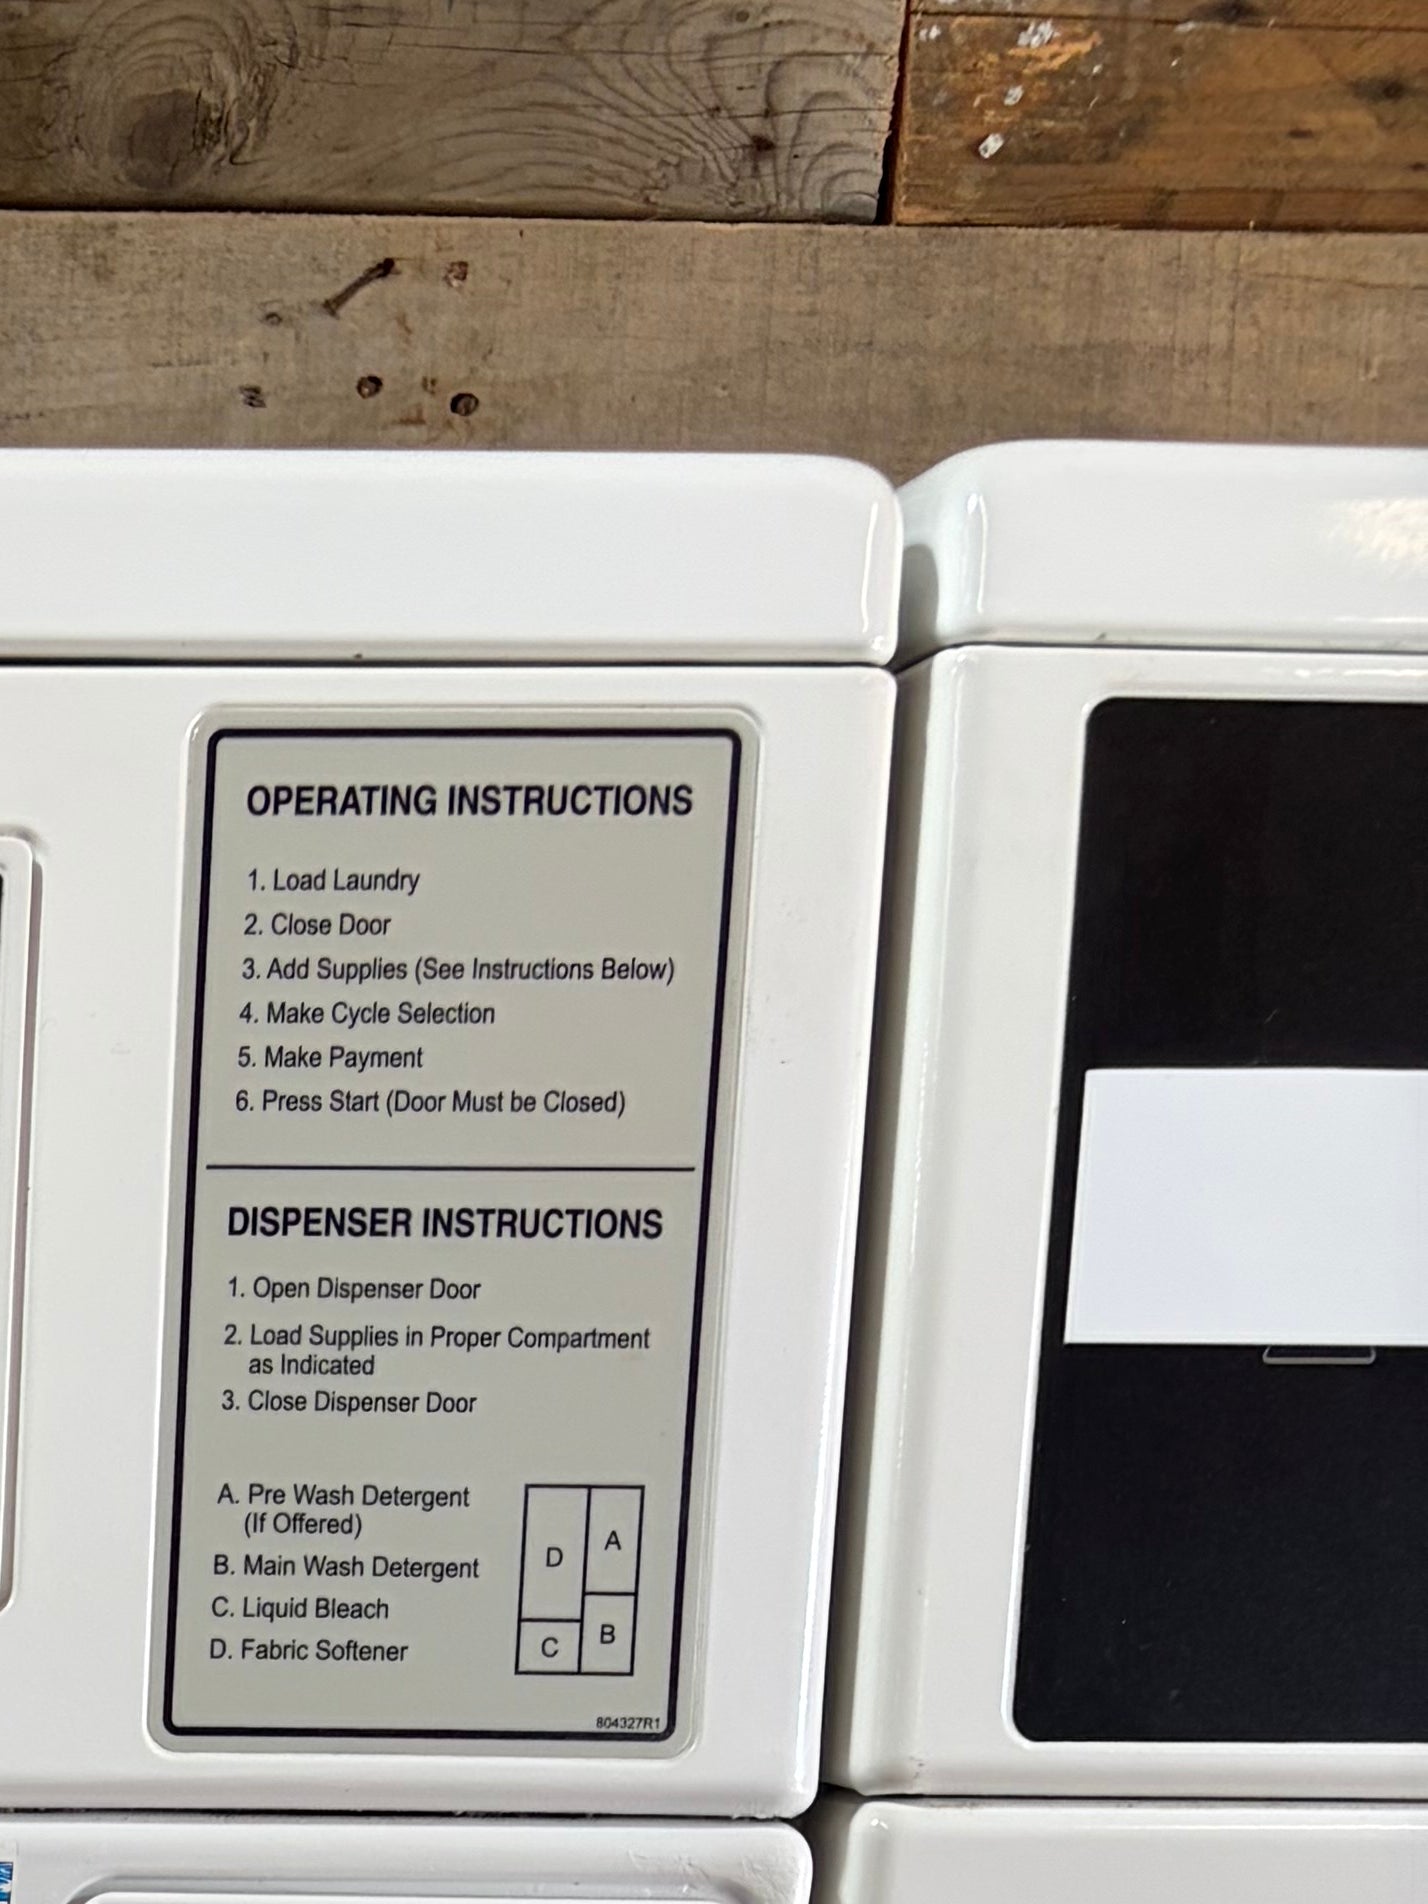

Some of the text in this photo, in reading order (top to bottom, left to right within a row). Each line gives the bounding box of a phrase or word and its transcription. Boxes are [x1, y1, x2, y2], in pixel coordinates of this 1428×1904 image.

[247, 784, 693, 816] OPERATING INSTRUCTIONS
[248, 867, 421, 897] 1. Load Laundry
[243, 912, 392, 936] 2. Close Door
[242, 956, 675, 987] 3. Add Supplies (See Instructions Below)
[239, 1001, 496, 1030] 4. Make Cycle Selection
[237, 1045, 423, 1074] 5. Make Payment
[235, 1088, 626, 1119] 6. Press Start (Door Must be Closed)
[228, 1206, 663, 1240] DISPENSER INSTRUCTIONS
[228, 1275, 482, 1304] 1. Open Dispenser Door
[223, 1323, 650, 1354] 2. Load Supplies in Proper Compartment
[248, 1353, 375, 1376] as Indicated
[221, 1388, 478, 1417] 3. Close Dispenser Door
[216, 1482, 470, 1513] A. Pre Wash Detergent
[244, 1511, 362, 1540] (If Offered)
[604, 1529, 622, 1551] A
[213, 1553, 480, 1584] B. Main Wash Detergent
[545, 1546, 564, 1568] D
[211, 1595, 389, 1624] C. Liquid Bleach
[541, 1636, 559, 1658] C
[599, 1623, 616, 1645] B
[209, 1637, 409, 1662] D. Fabric Softener
[595, 1716, 661, 1730] 804327R1
